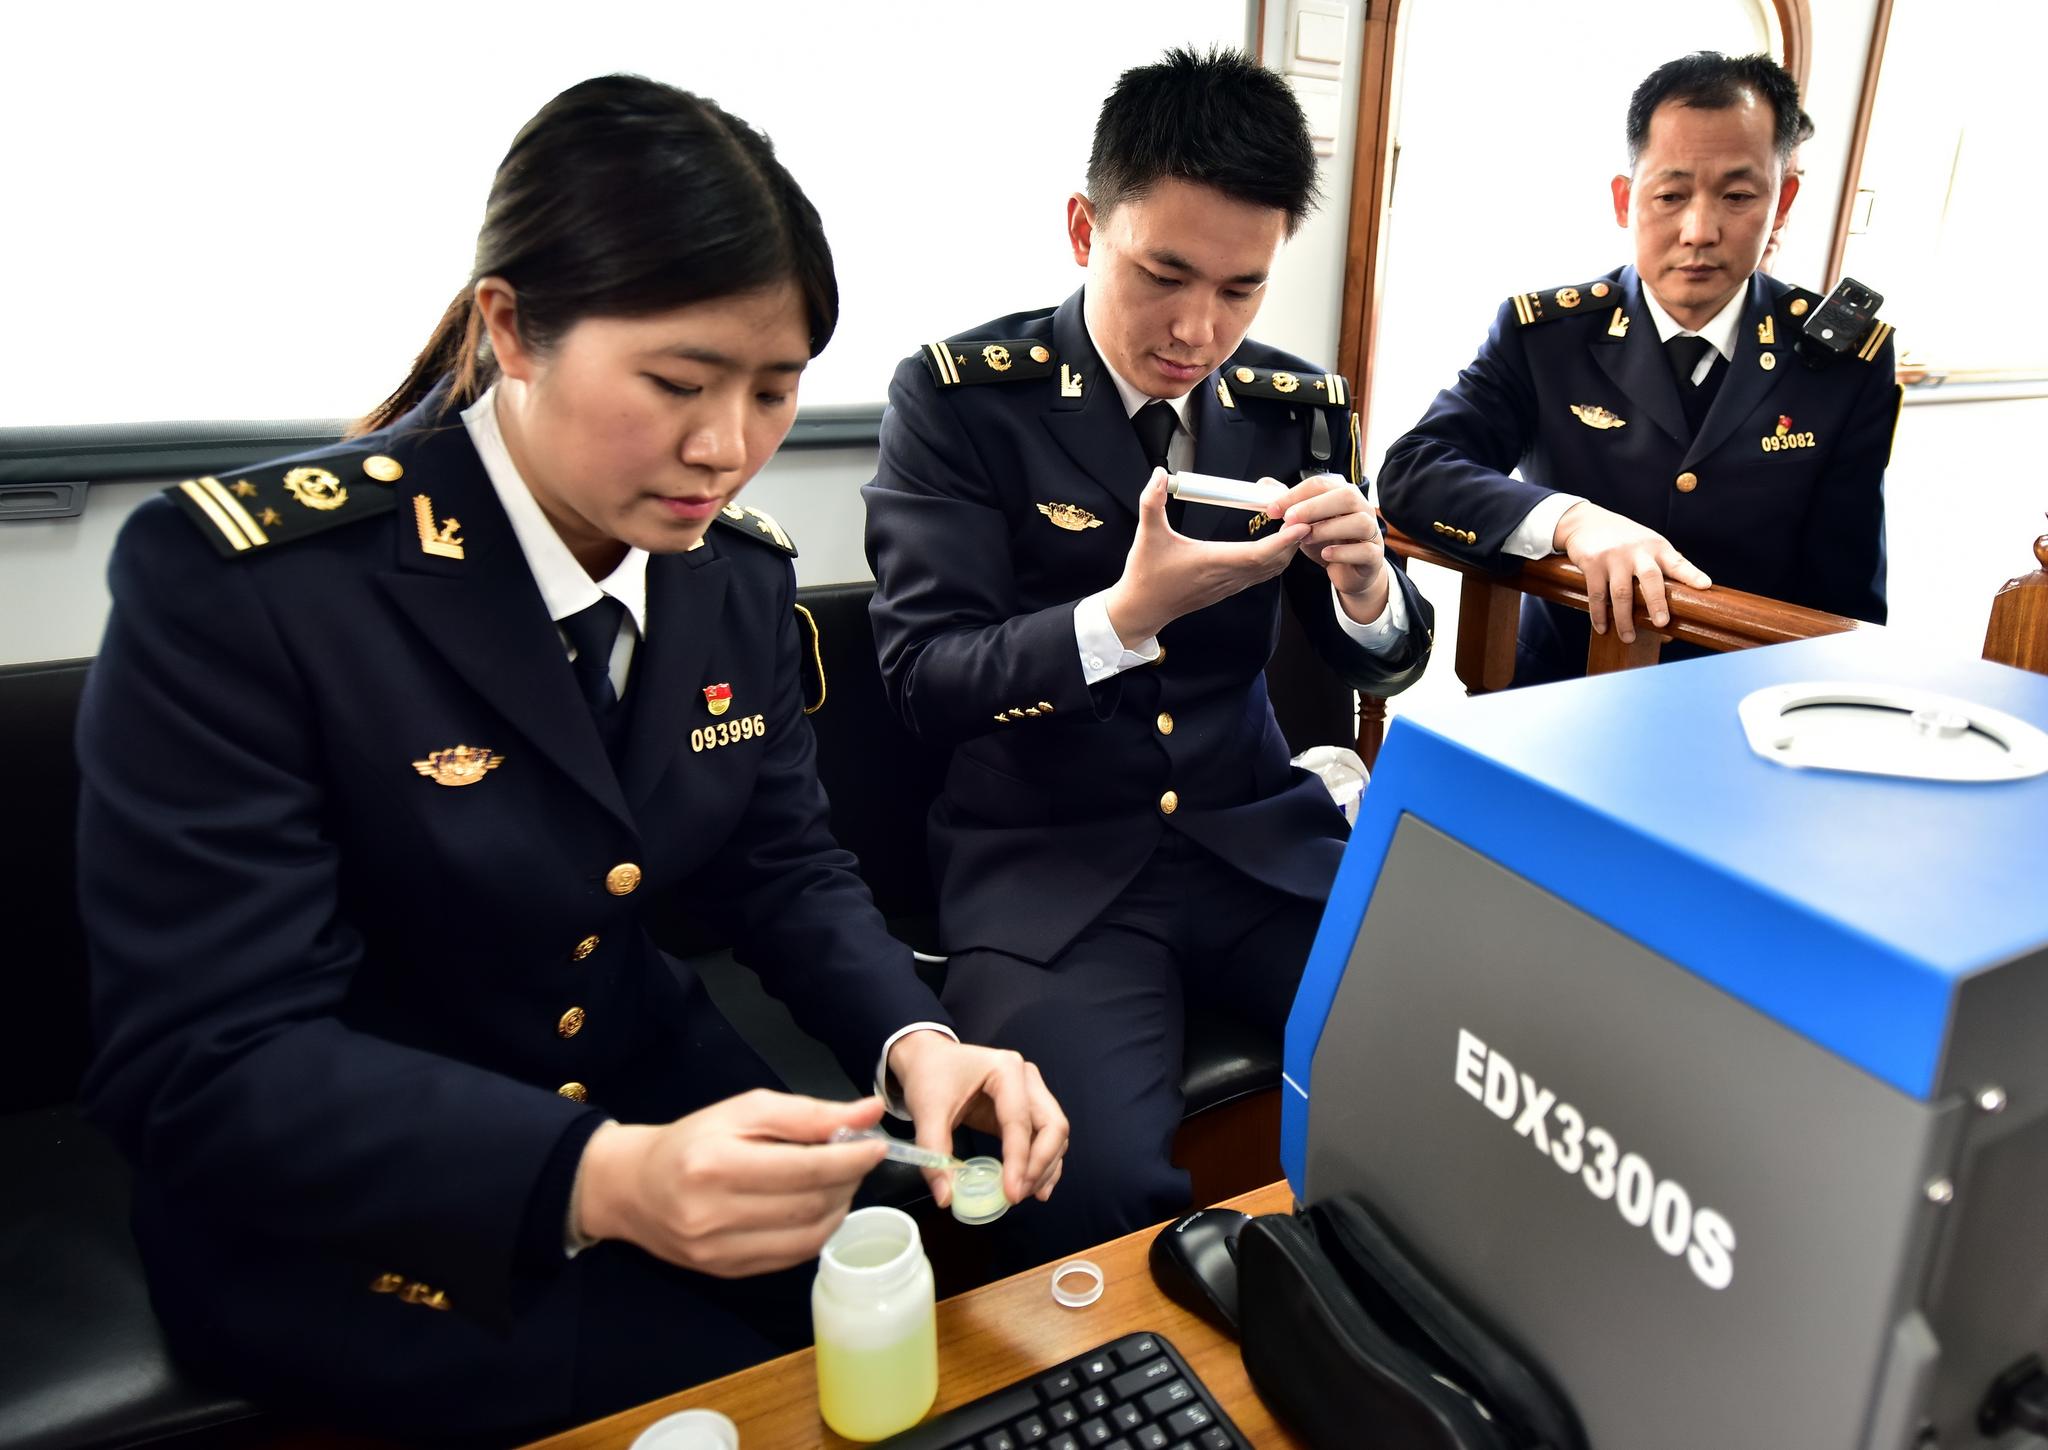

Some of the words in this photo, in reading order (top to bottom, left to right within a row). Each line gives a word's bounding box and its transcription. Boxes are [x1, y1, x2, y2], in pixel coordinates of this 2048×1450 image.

[1761, 432, 1816, 452] 093082
[691, 714, 765, 752] 093996
[1455, 1028, 1736, 1290] EDX3300S
